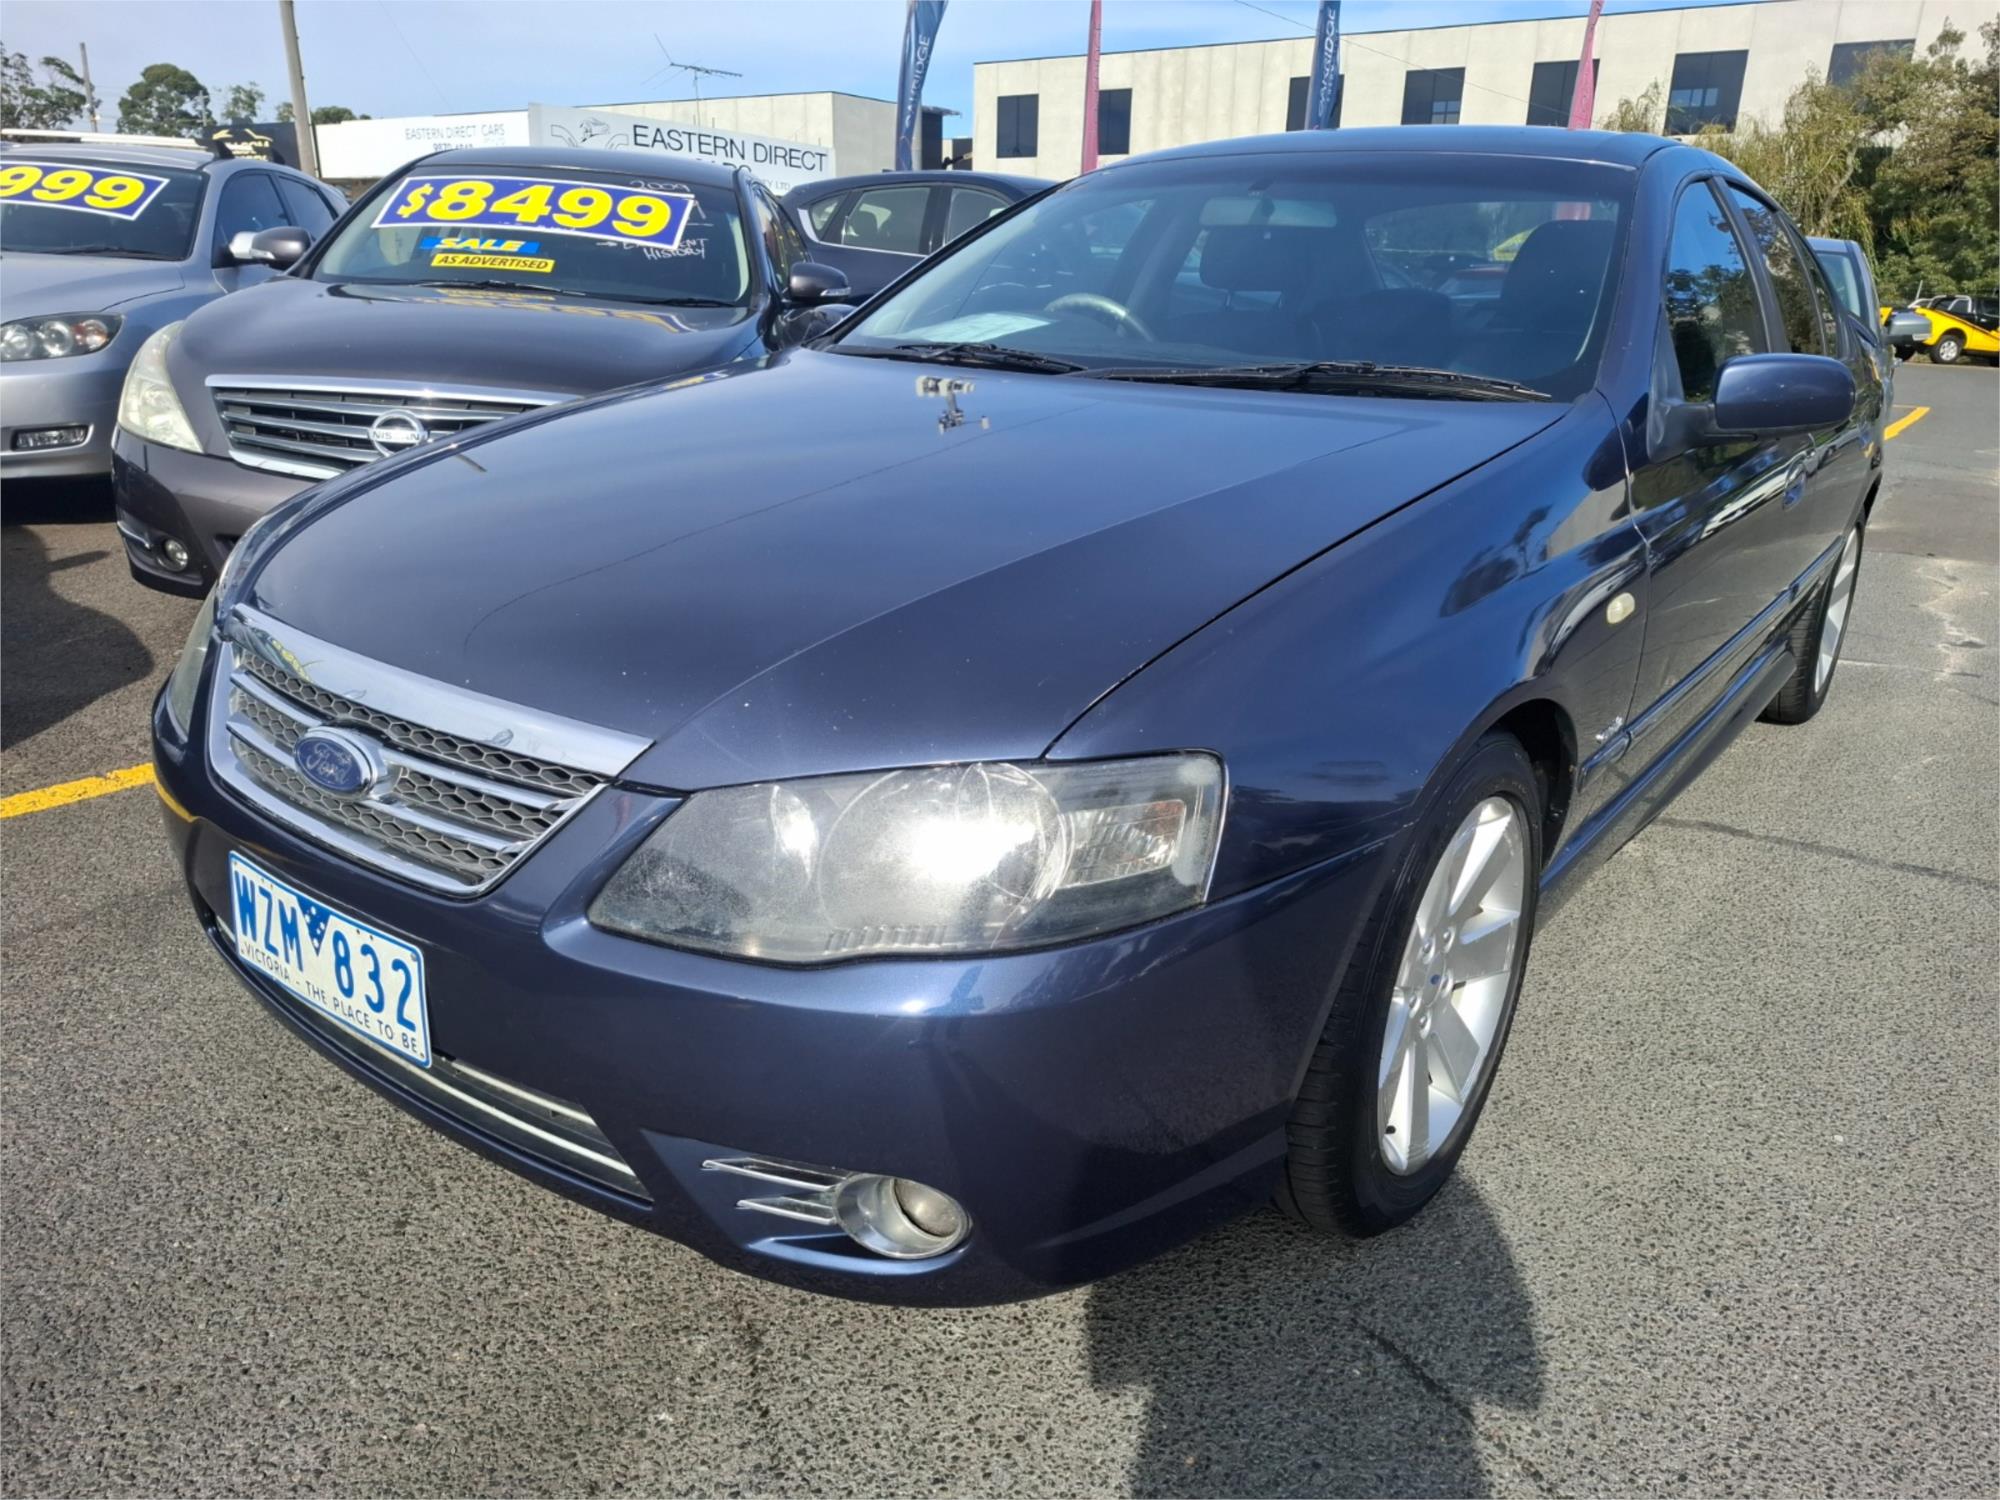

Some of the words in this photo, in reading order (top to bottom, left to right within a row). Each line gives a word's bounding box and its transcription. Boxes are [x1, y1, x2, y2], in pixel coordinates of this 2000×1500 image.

[405, 127, 444, 140] EASTERN
[446, 125, 477, 139] DIRECT
[481, 123, 505, 137] CARS
[633, 124, 746, 160] EASTERN
[753, 142, 827, 172] DIRECT
[396, 180, 672, 238] $8499
[435, 237, 526, 252] SALE
[439, 255, 460, 264] AS
[460, 256, 549, 270] ADVERTISED
[234, 870, 304, 972] WZM
[332, 930, 417, 1033] 832
[243, 941, 291, 981] VICTORIA
[305, 980, 328, 1005] THE
[332, 996, 371, 1030] PLACE
[376, 1020, 394, 1041] TO
[401, 1032, 418, 1053] BE
